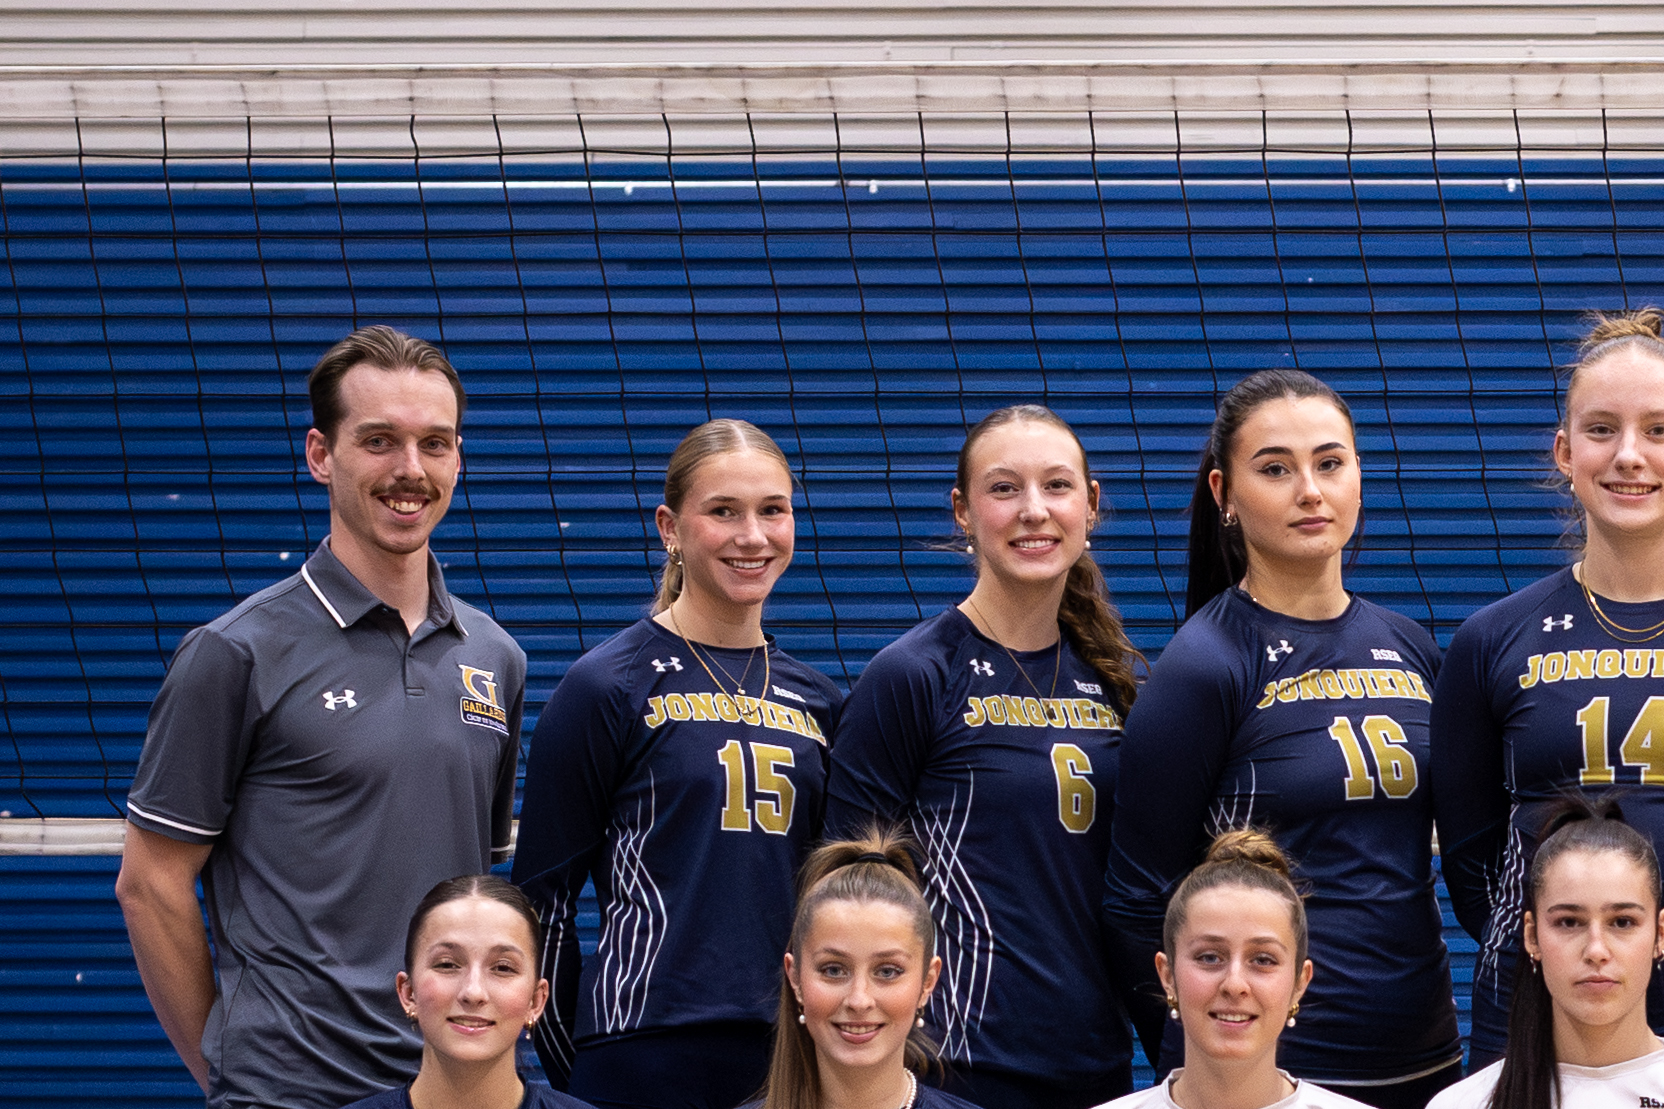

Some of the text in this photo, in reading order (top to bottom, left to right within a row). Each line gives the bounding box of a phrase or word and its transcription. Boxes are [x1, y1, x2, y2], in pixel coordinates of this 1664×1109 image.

[1370, 648, 1404, 662] RSEQ
[963, 694, 1124, 731] JONQUIER
[1256, 669, 1432, 709] JONQUIERE
[718, 739, 796, 836] 15
[1050, 743, 1096, 834] 6
[1330, 715, 1419, 800] 16
